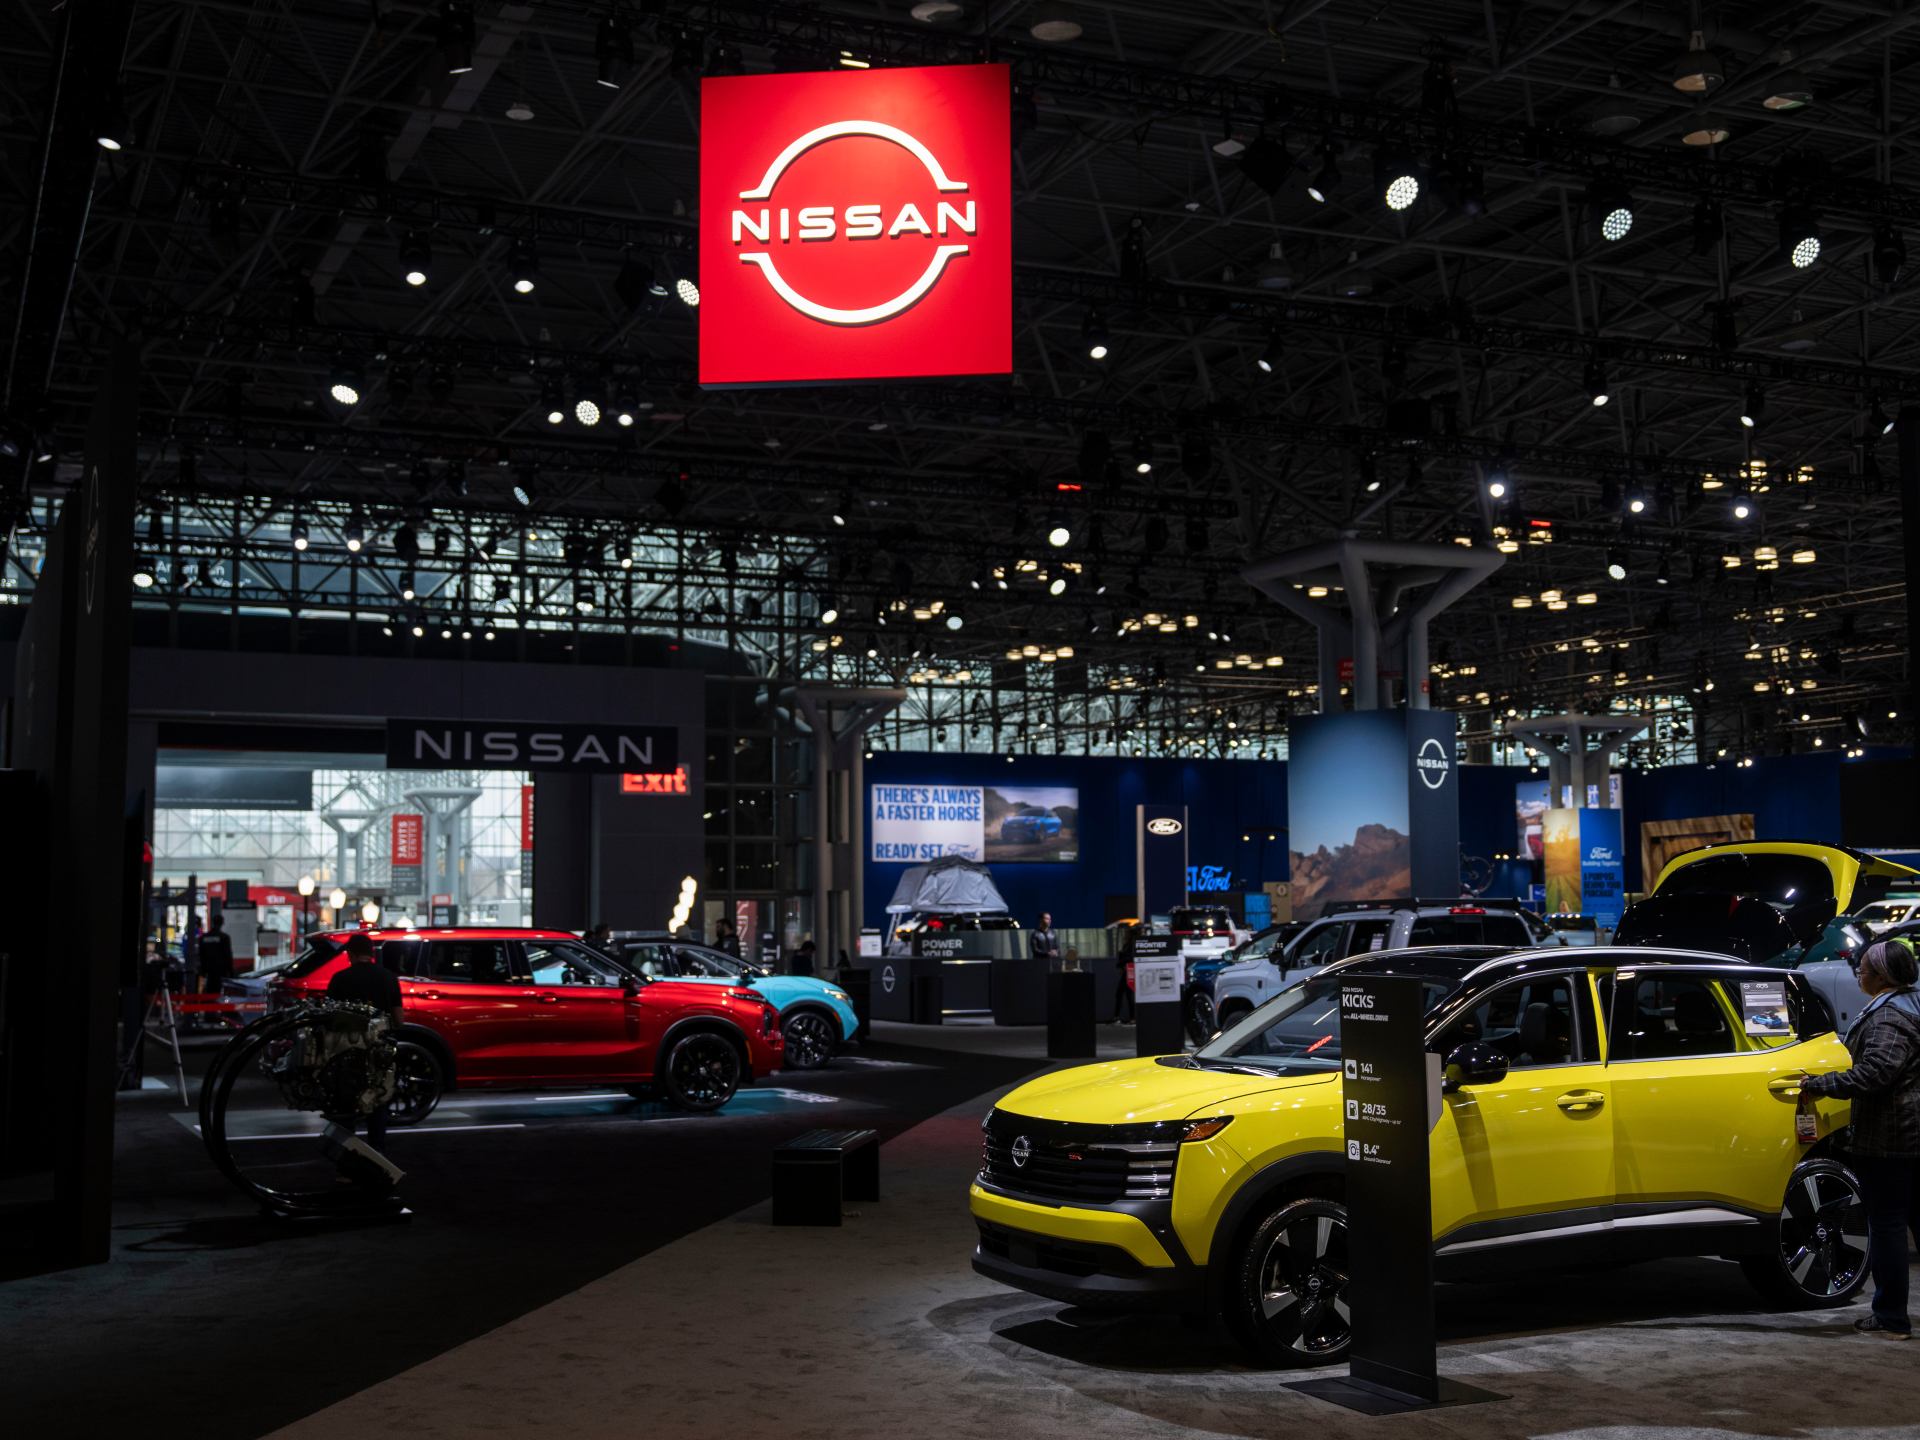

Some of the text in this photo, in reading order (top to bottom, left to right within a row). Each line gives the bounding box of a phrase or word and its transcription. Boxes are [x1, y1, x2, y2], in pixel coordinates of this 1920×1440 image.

[731, 200, 977, 244] NISSAN
[414, 729, 653, 765] NISSAN
[1416, 758, 1449, 770] NISSAN
[875, 788, 981, 805] THERE'S ALWAYS
[876, 805, 981, 821] A FASTER HORSE
[875, 843, 917, 859] READY
[920, 844, 944, 859] SET
[1590, 846, 1613, 859] Ford
[1198, 865, 1232, 891] Ford
[922, 939, 963, 949] POWER
[1360, 1063, 1373, 1074] 141
[1362, 1103, 1386, 1116] 28/35
